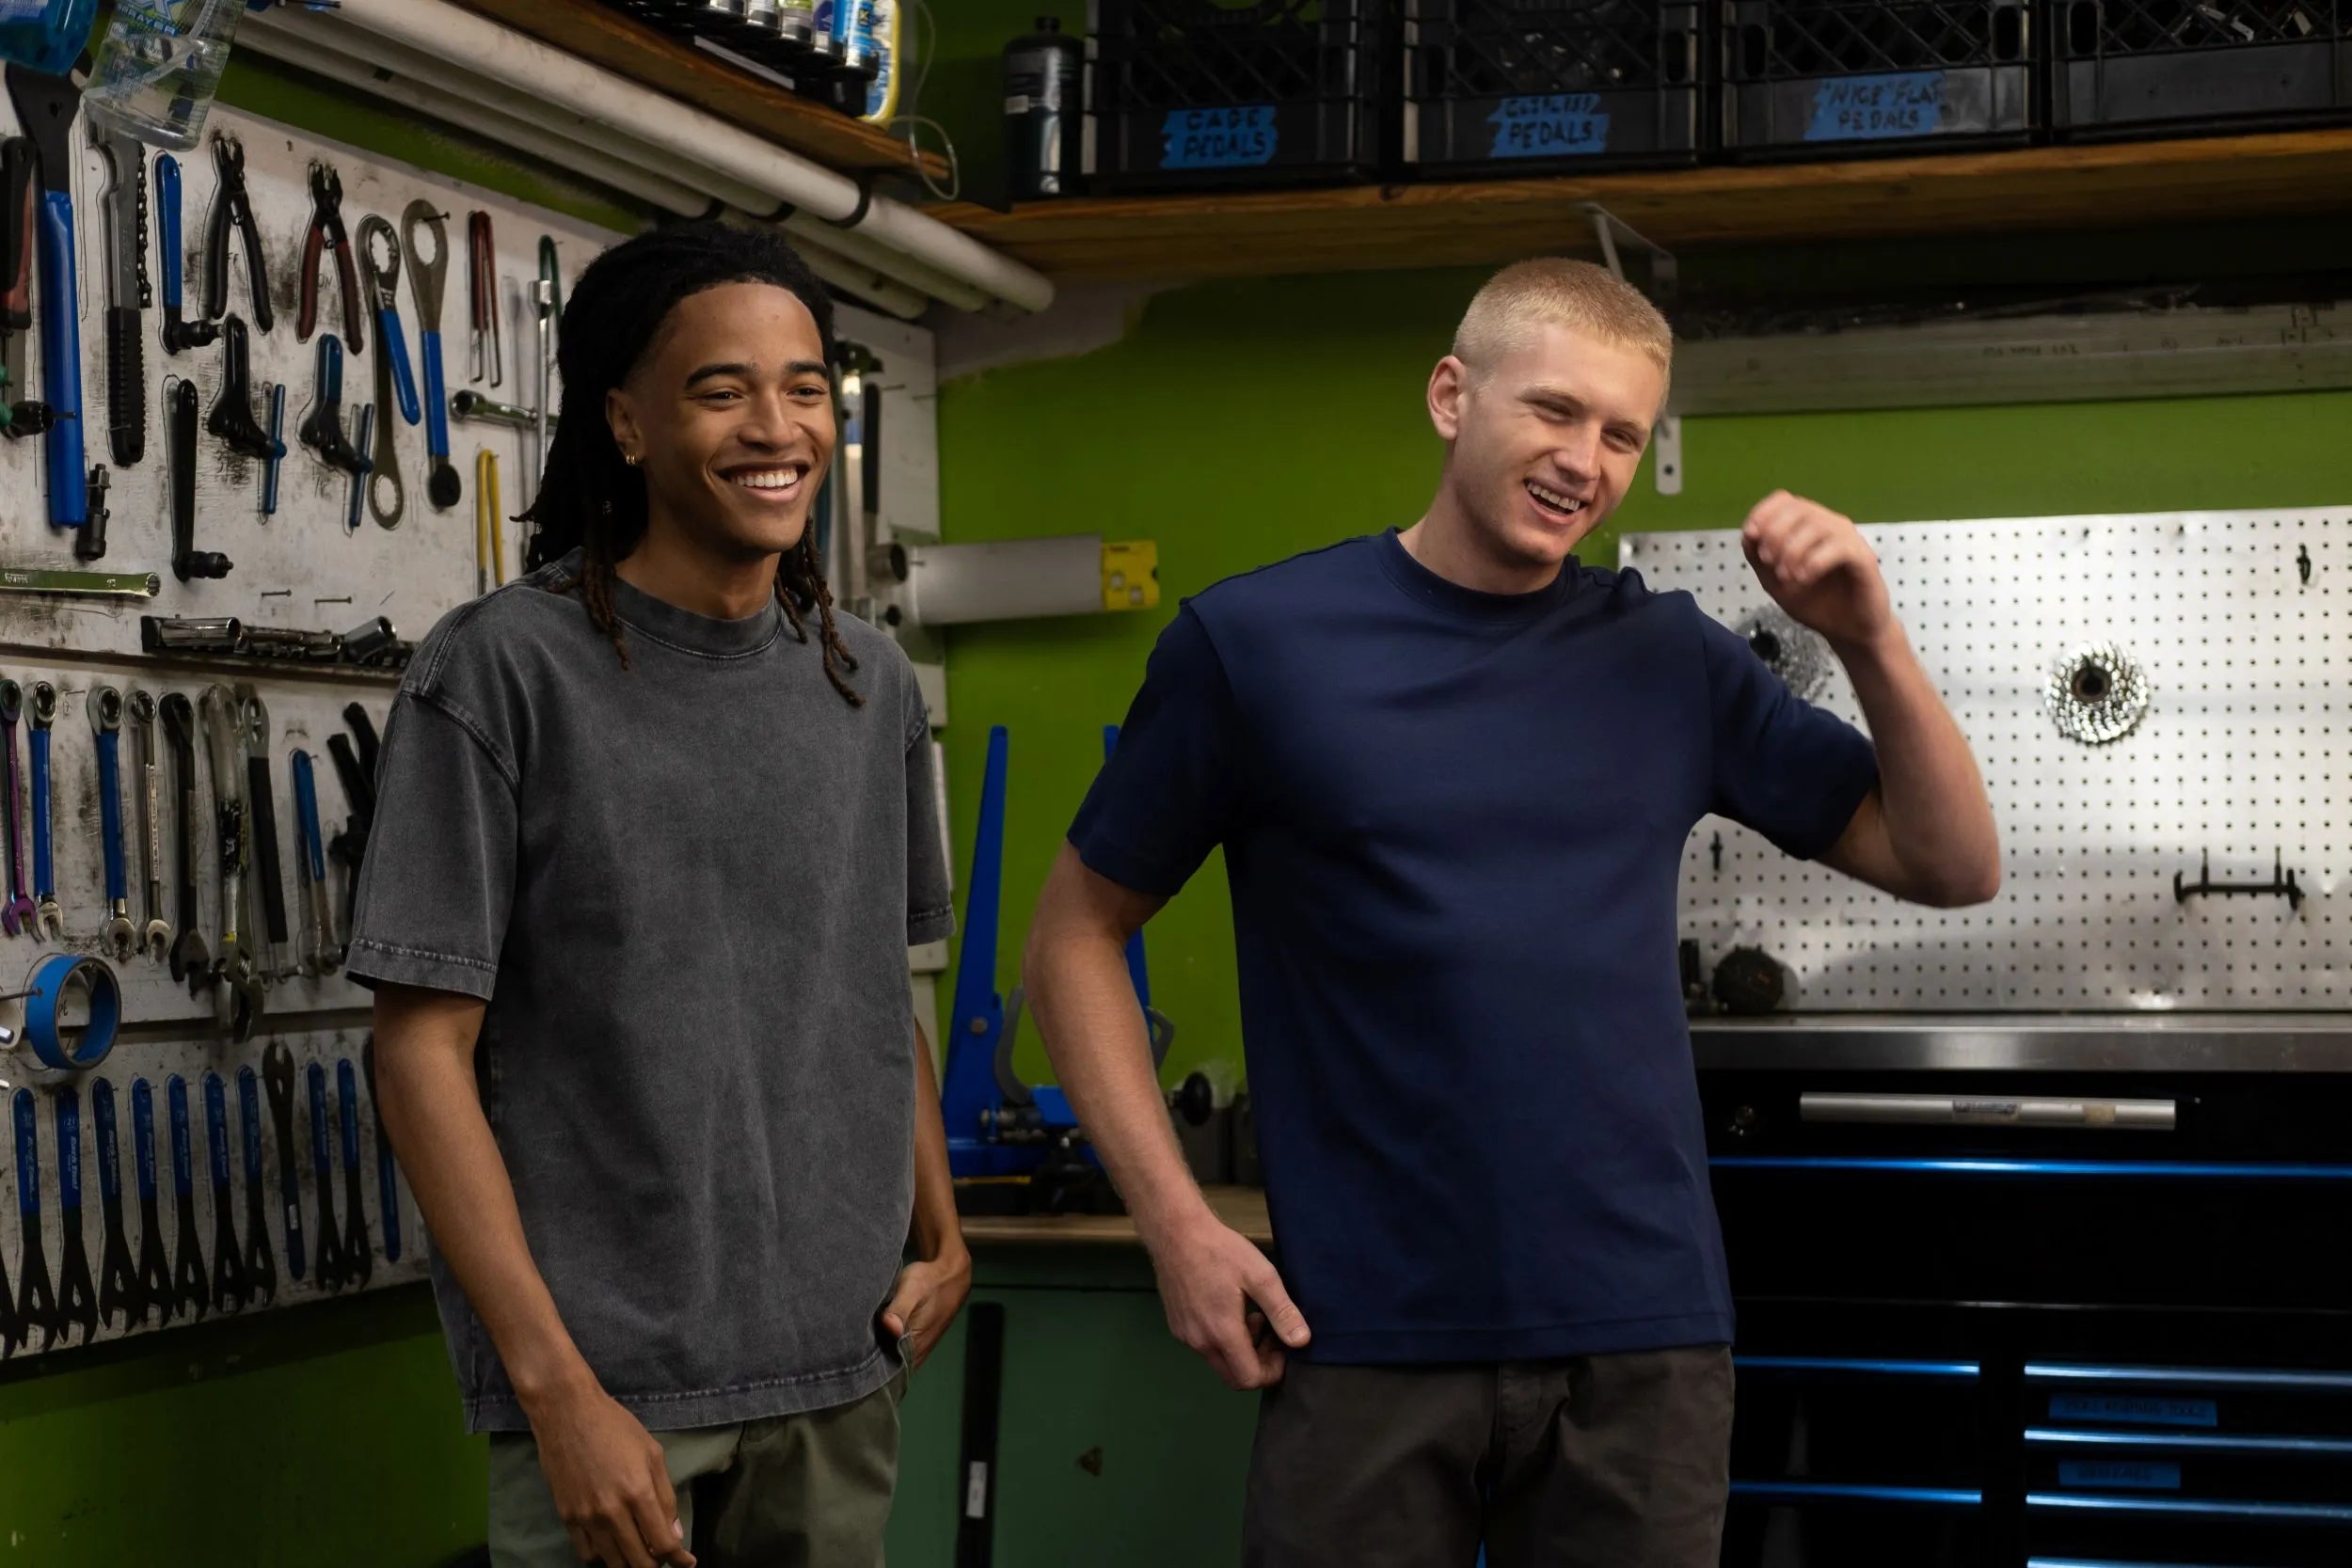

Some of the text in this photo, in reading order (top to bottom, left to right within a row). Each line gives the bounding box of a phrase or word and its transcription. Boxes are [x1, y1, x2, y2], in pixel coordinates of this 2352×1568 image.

[1508, 120, 1593, 149] PEDALS
[1838, 108, 1920, 133] PEDALS
[1184, 131, 1266, 161] PEDALS
